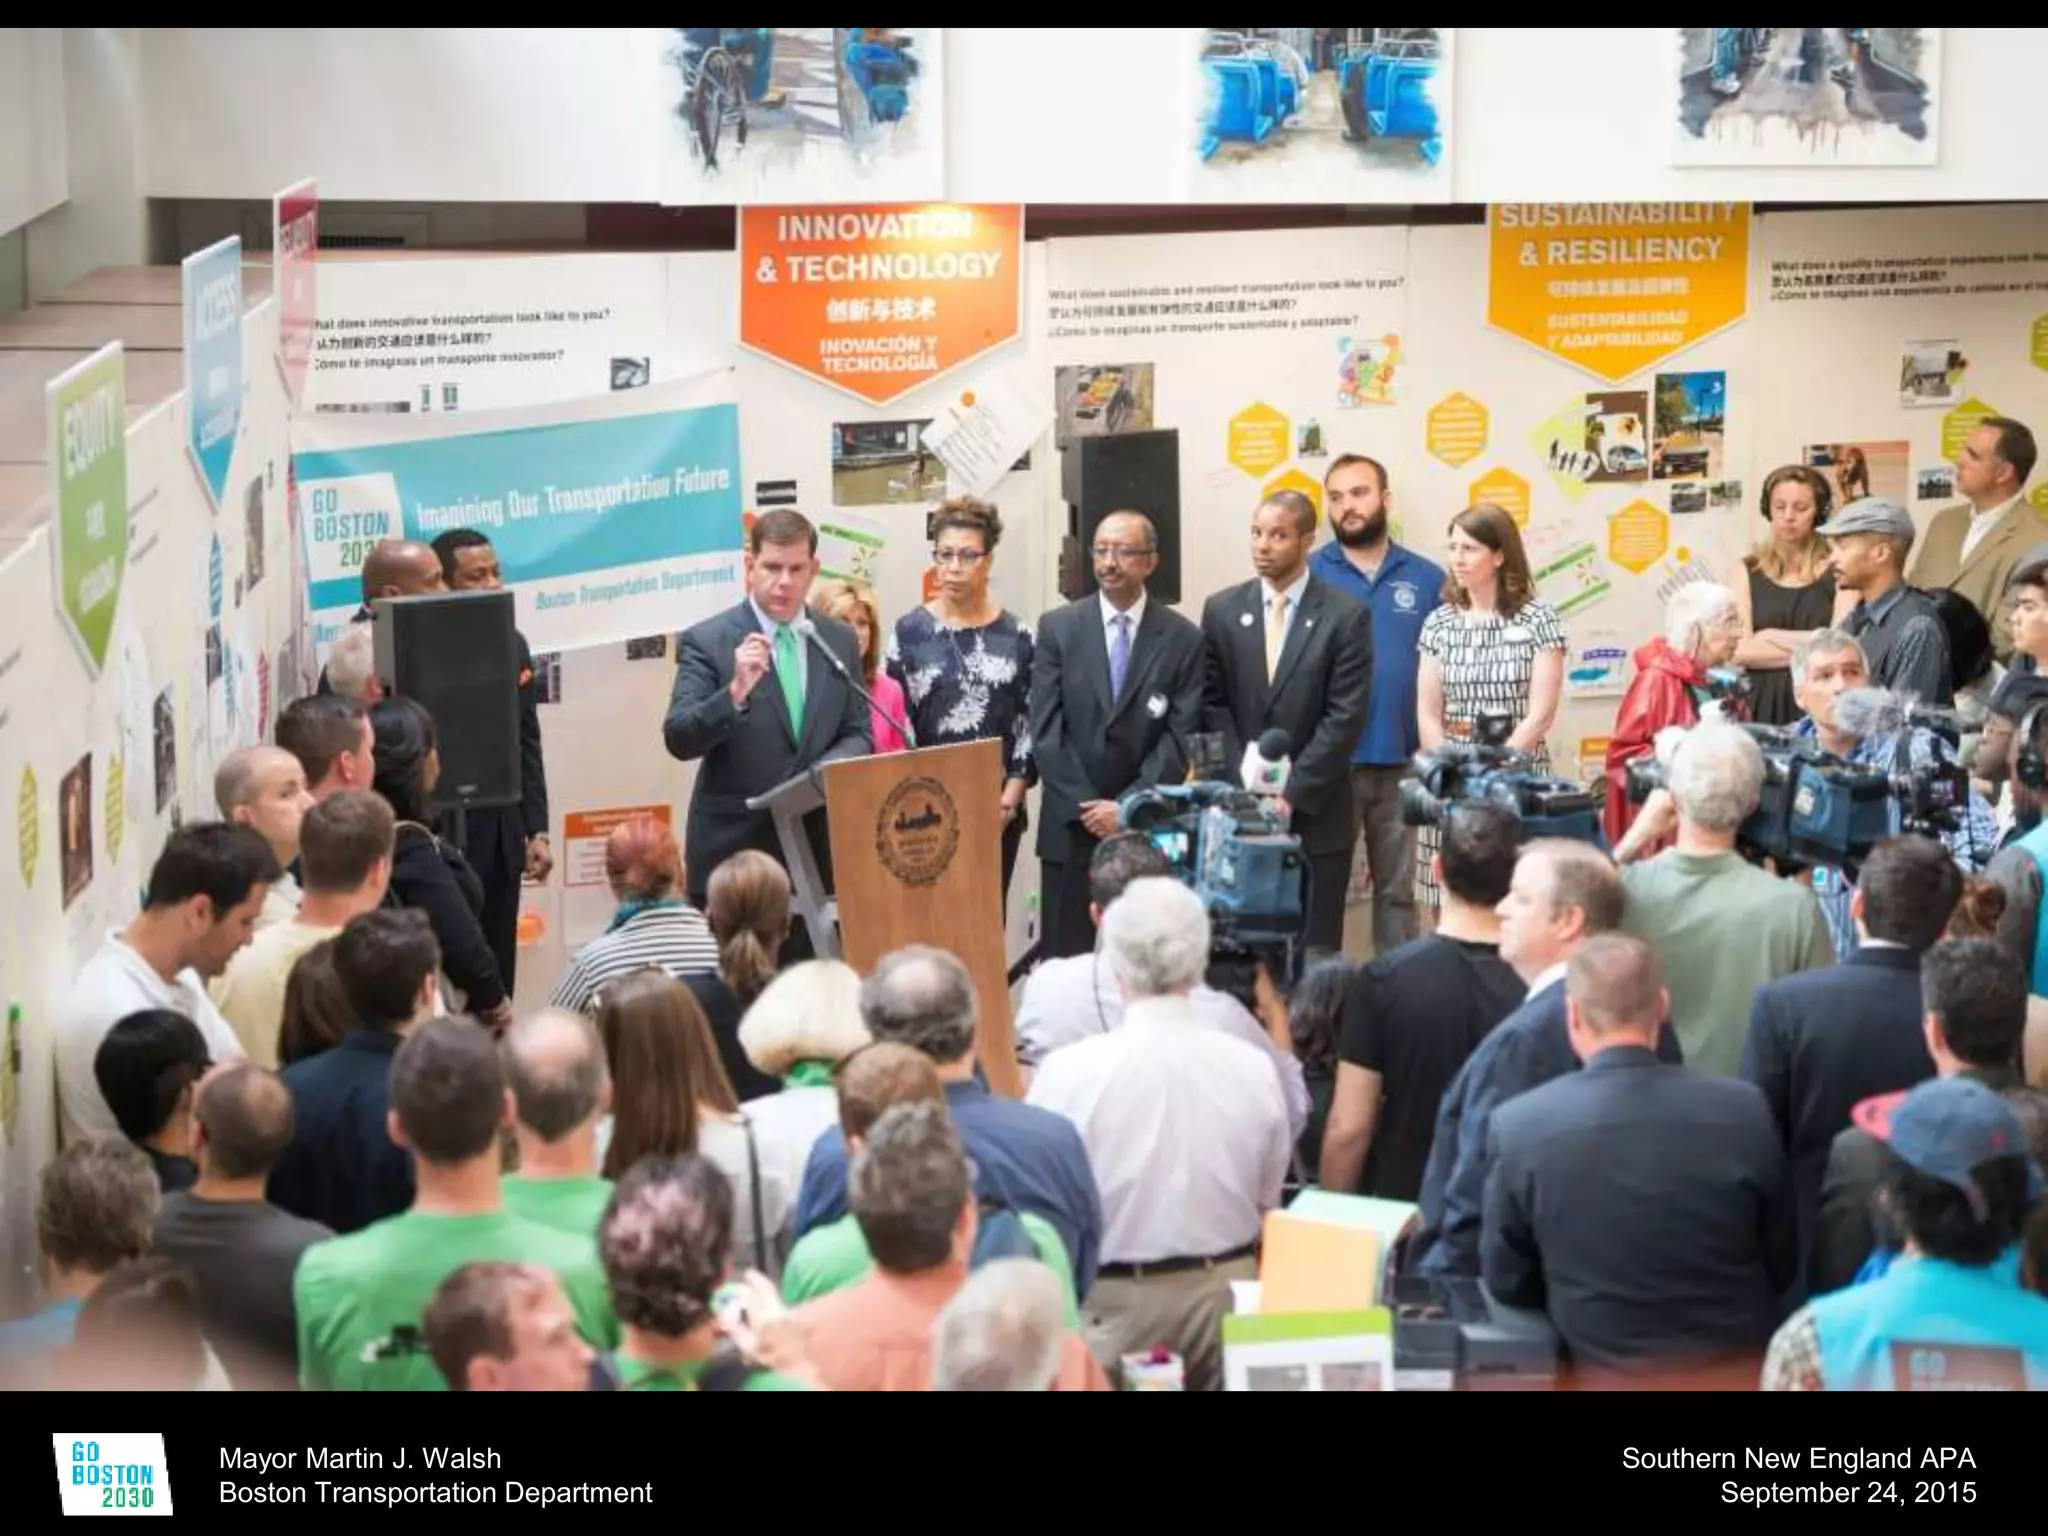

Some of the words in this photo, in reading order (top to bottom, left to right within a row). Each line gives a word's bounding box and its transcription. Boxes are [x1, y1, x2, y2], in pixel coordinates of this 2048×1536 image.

[779, 212, 972, 241] INNOVATION
[1500, 203, 1737, 228] SUSTAINABILITY
[1519, 241, 1540, 267] &
[1548, 236, 1724, 265] RESILIENCY
[756, 256, 778, 283] &
[786, 251, 1001, 283] TECHNOLOGY
[337, 318, 366, 329] does
[431, 311, 513, 326] transportation
[1547, 310, 1688, 329] SUSTENTABILIDAD
[926, 335, 938, 351] Y
[65, 379, 116, 481] EQUITY
[313, 489, 338, 514] GO
[416, 495, 504, 529] Imagining
[509, 490, 538, 518] Our
[546, 474, 670, 515] Transportation
[675, 467, 729, 496] Future
[314, 511, 389, 542] BOSTON
[661, 564, 735, 594] Department
